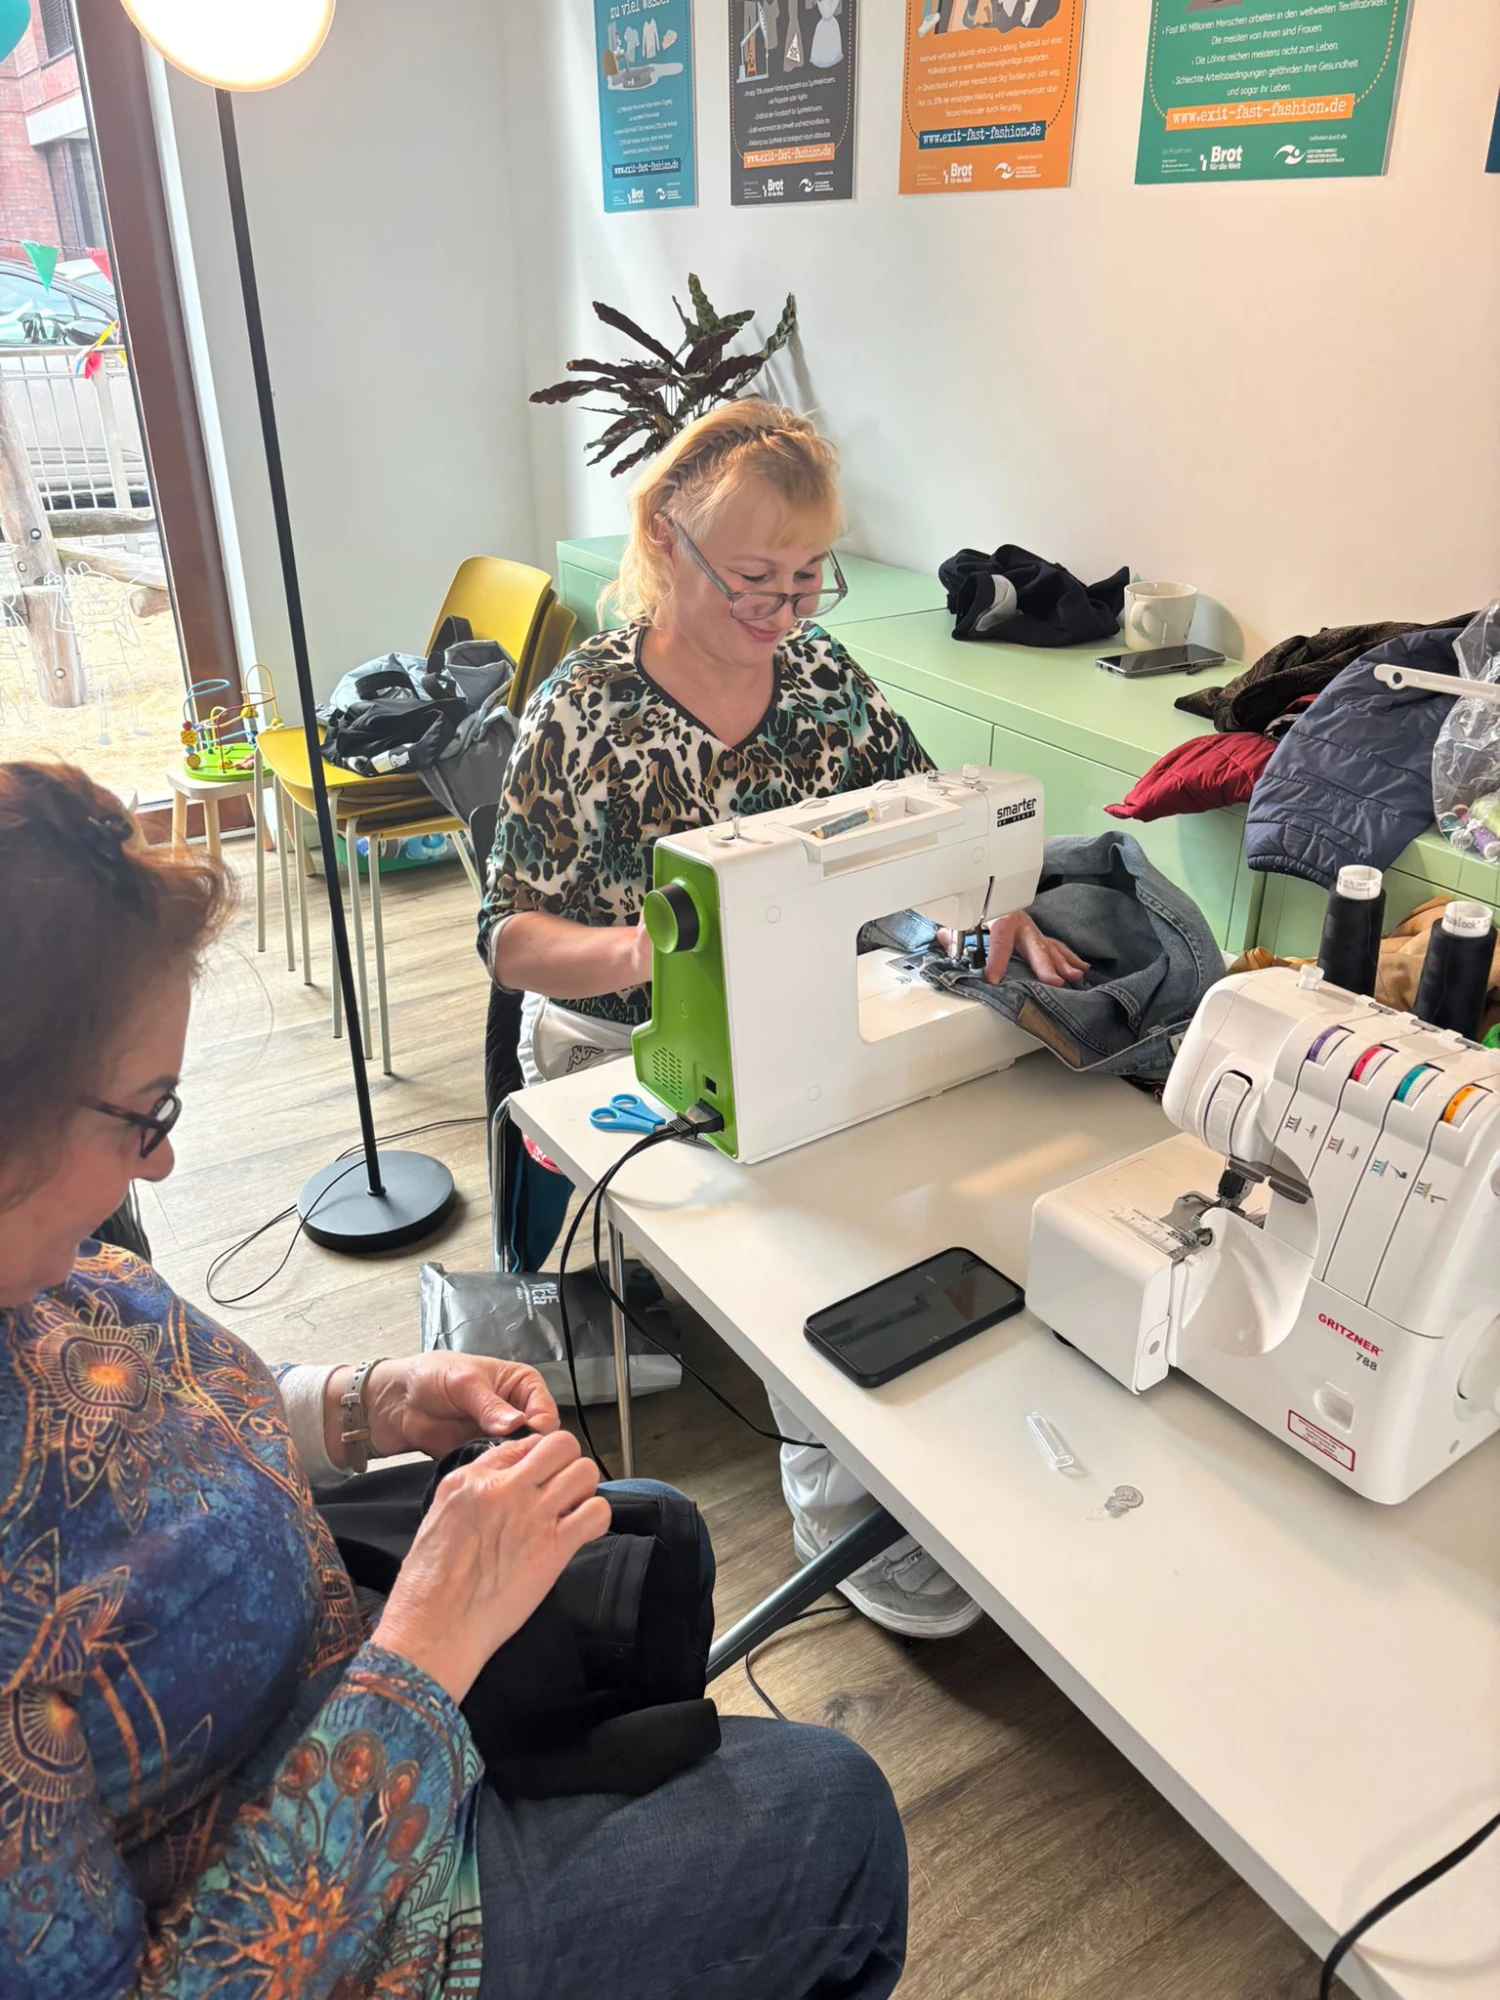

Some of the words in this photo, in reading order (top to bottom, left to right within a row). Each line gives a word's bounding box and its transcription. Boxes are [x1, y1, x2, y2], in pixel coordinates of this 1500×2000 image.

[1165, 25, 1178, 35] Fast
[1179, 24, 1187, 33] 80
[1189, 21, 1215, 31] Millionen
[1216, 17, 1248, 28] Menschen
[1248, 13, 1276, 23] arbeiten
[1277, 11, 1283, 20] in
[1284, 9, 1298, 19] den
[1299, 4, 1336, 17] weltweiten
[1211, 36, 1222, 45] Die
[1223, 33, 1248, 44] meisten
[1249, 32, 1261, 40] von
[1282, 25, 1297, 37] sind
[1195, 56, 1206, 65] Die
[1207, 54, 1226, 64] Löhne
[1226, 52, 1250, 62] reichen
[1251, 48, 1281, 59] meistens
[1281, 45, 1299, 56] nicht
[1299, 45, 1315, 54] zum
[1205, 69, 1268, 82] Arbeitsbedingungen
[1268, 65, 1303, 78] gefährden
[1318, 59, 1359, 71] Gesundheit
[1226, 86, 1240, 97] und
[1240, 86, 1259, 97] sogar
[1172, 97, 1346, 124] www.exit-fast-fashion.de
[923, 123, 1041, 144] www.exit-fast-fashion.de
[1210, 145, 1243, 163] Brot
[950, 163, 972, 177] Brot
[1209, 163, 1218, 171] für
[1218, 162, 1227, 170] die
[1227, 162, 1241, 170] Welt
[768, 179, 784, 191] Brot
[997, 798, 1037, 819] smarter
[1318, 1313, 1379, 1356] GRITZNER
[1356, 1352, 1378, 1372] 788
